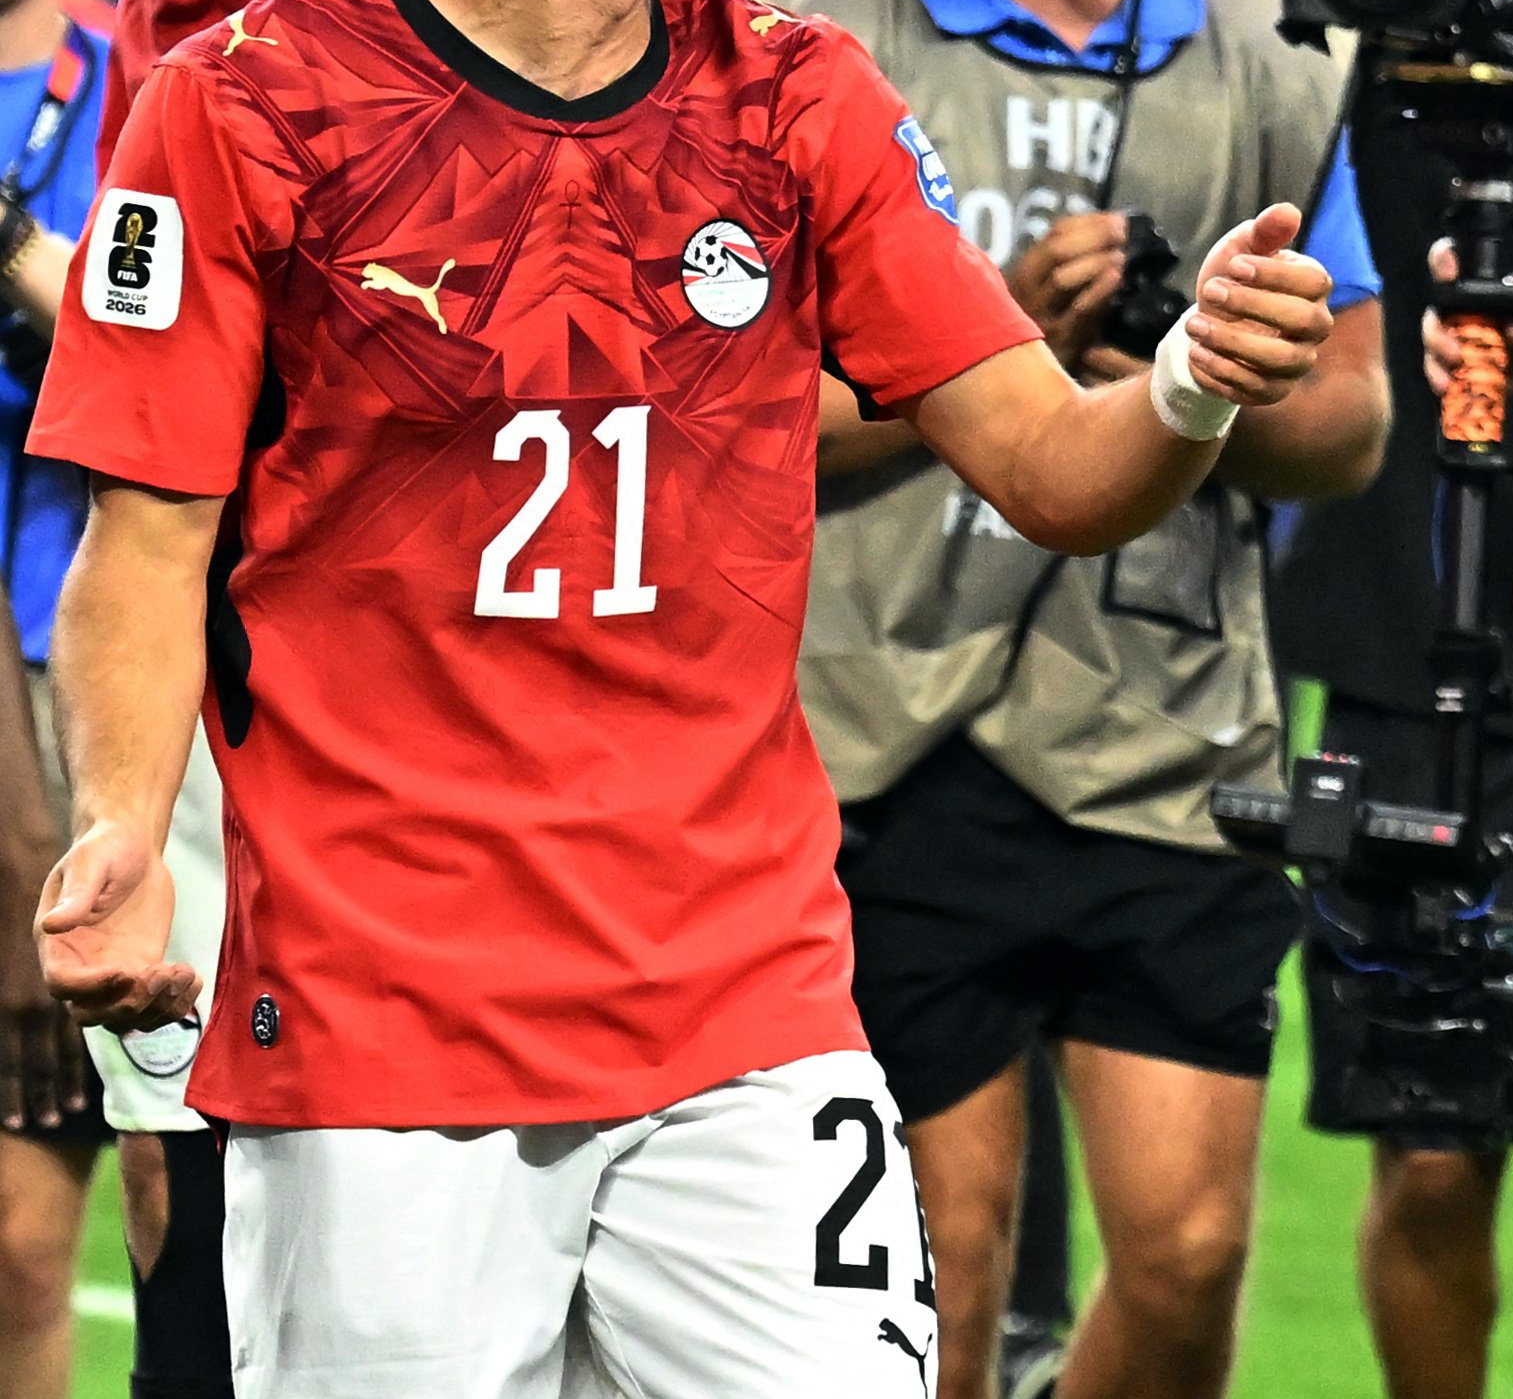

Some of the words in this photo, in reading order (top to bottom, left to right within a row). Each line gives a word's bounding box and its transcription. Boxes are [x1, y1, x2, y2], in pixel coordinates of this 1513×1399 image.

[117, 269, 138, 282] FIFA
[105, 299, 146, 316] 2026
[476, 404, 658, 620] 21
